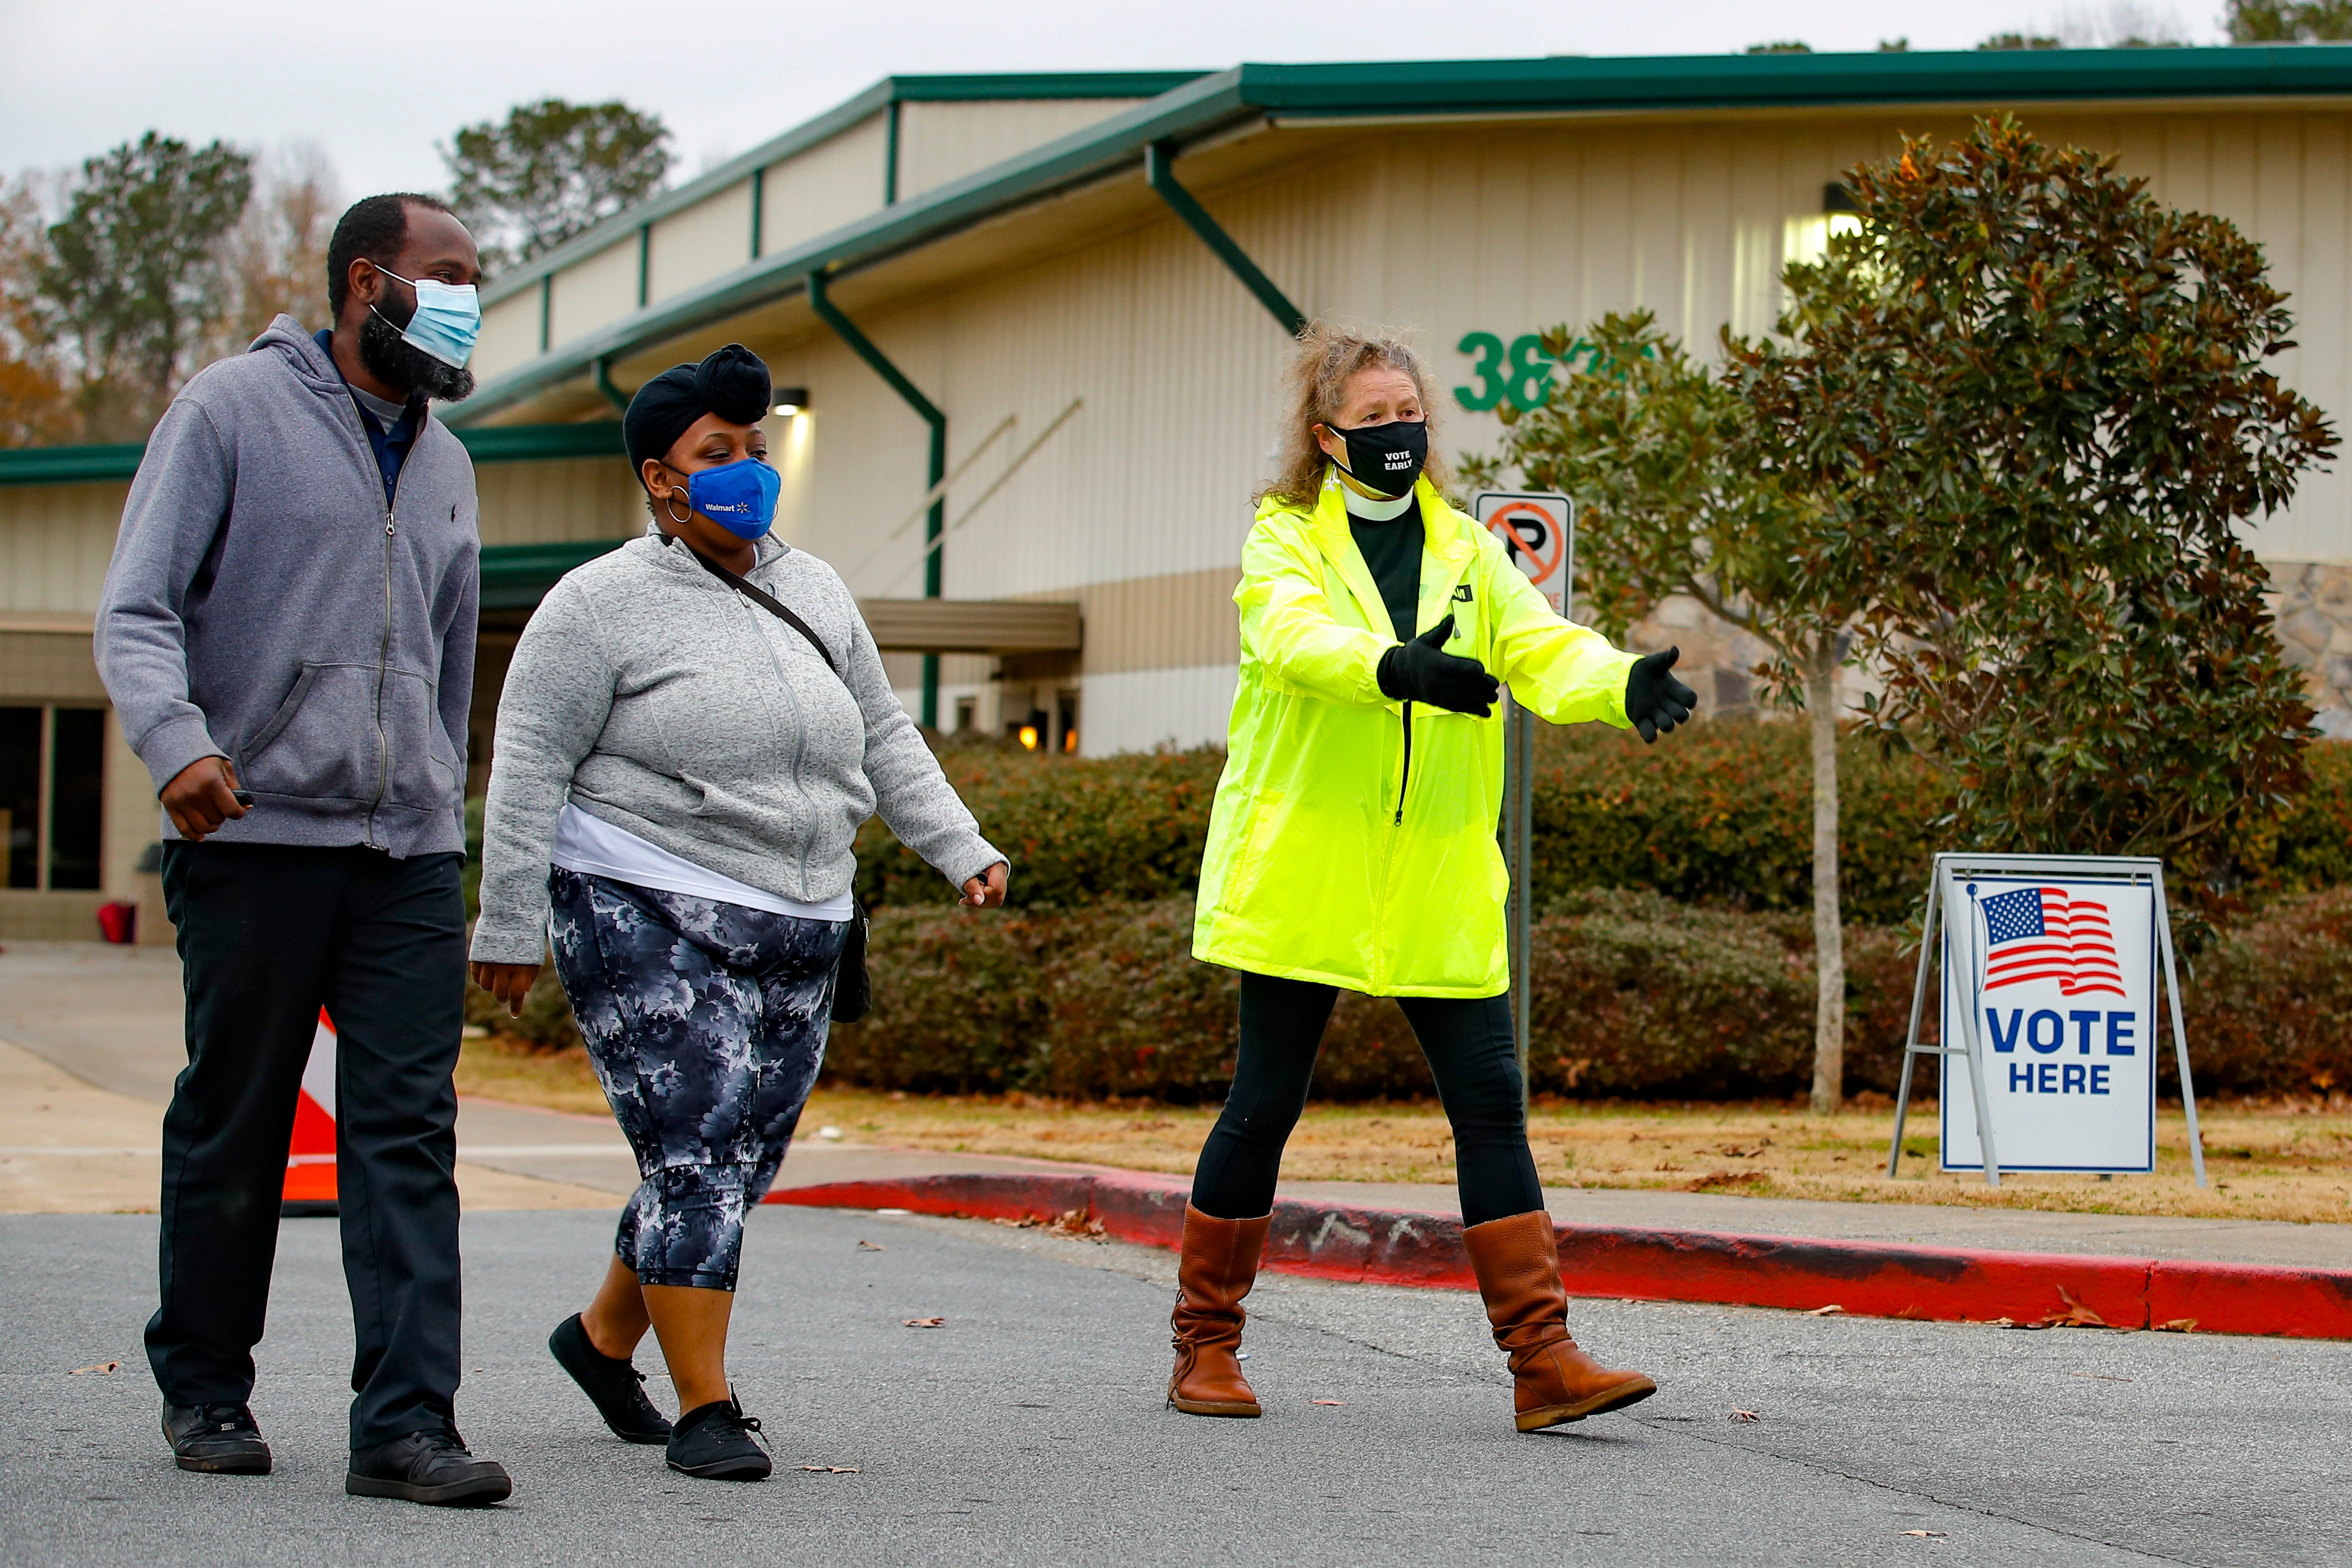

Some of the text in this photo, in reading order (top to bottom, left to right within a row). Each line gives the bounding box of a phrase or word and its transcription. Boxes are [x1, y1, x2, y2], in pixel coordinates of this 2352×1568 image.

[1385, 450, 1411, 461] VOTE
[1384, 459, 1412, 470] EARLY
[705, 503, 735, 512] Walmart
[1985, 1007, 2136, 1056] VOTE
[2009, 1063, 2111, 1095] HERE
